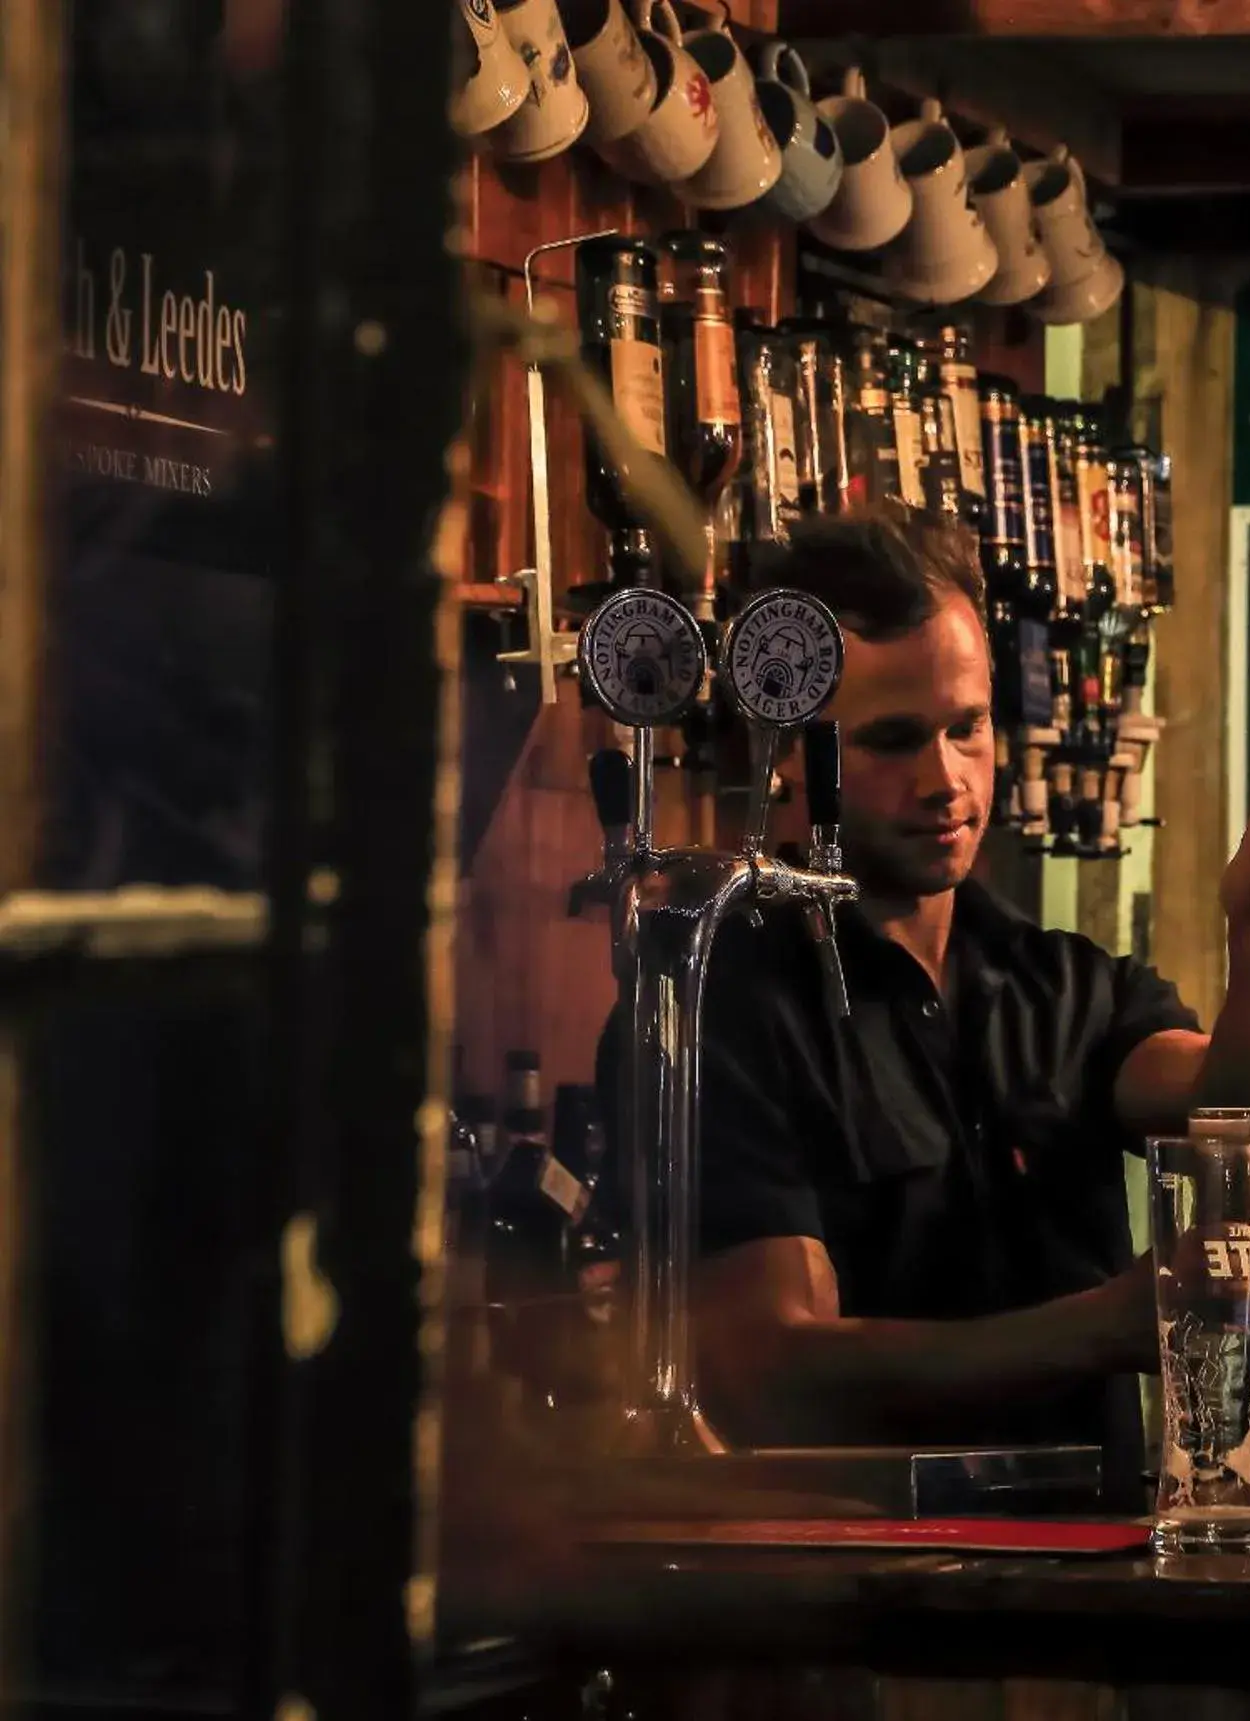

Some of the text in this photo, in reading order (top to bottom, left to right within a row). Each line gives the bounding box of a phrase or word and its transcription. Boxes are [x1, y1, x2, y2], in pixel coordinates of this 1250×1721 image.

[106, 246, 133, 367] &
[139, 252, 247, 396] Leedes
[143, 455, 213, 498] MIXERS
[597, 599, 676, 682] NOTTINGHAM
[736, 602, 833, 699] NOTTINGHAM ROAD
[741, 680, 803, 717] LAGER
